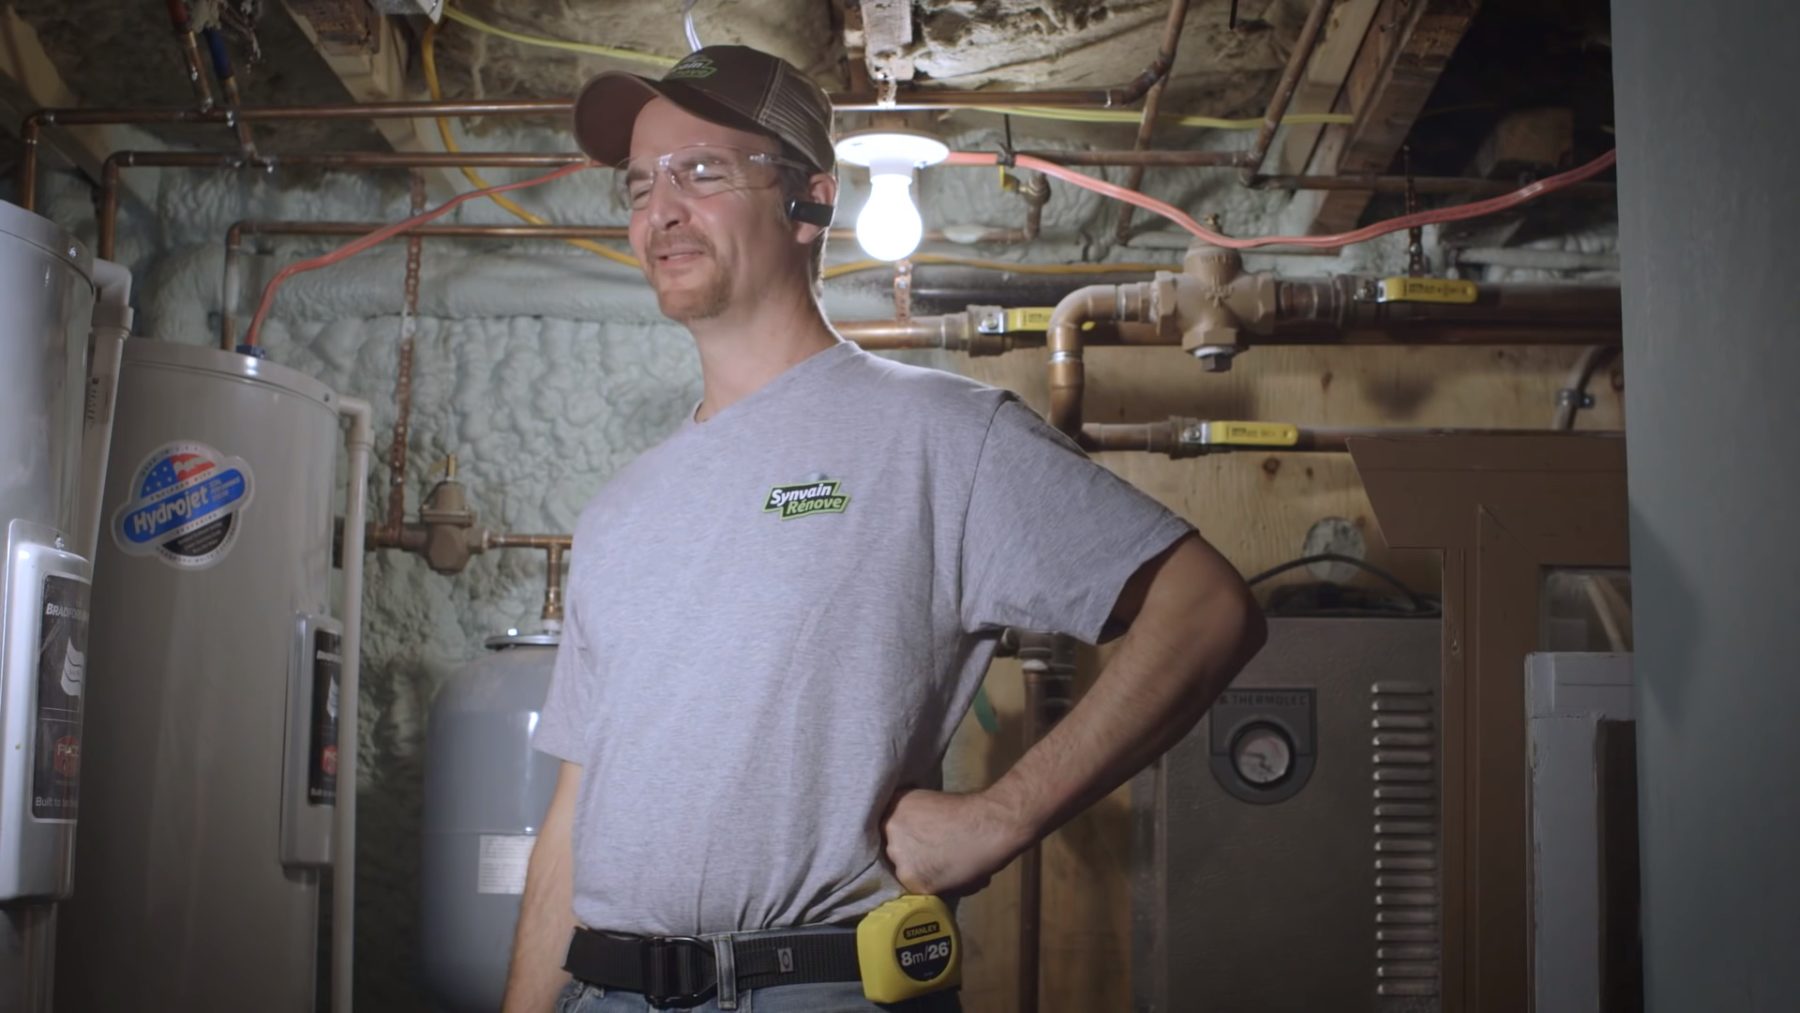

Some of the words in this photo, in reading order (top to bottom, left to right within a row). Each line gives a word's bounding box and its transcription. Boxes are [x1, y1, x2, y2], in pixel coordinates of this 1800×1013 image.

[769, 483, 832, 507] Synvain
[786, 496, 842, 515] Rénove
[133, 485, 209, 535] Hydrojet
[905, 924, 938, 938] STANLEY
